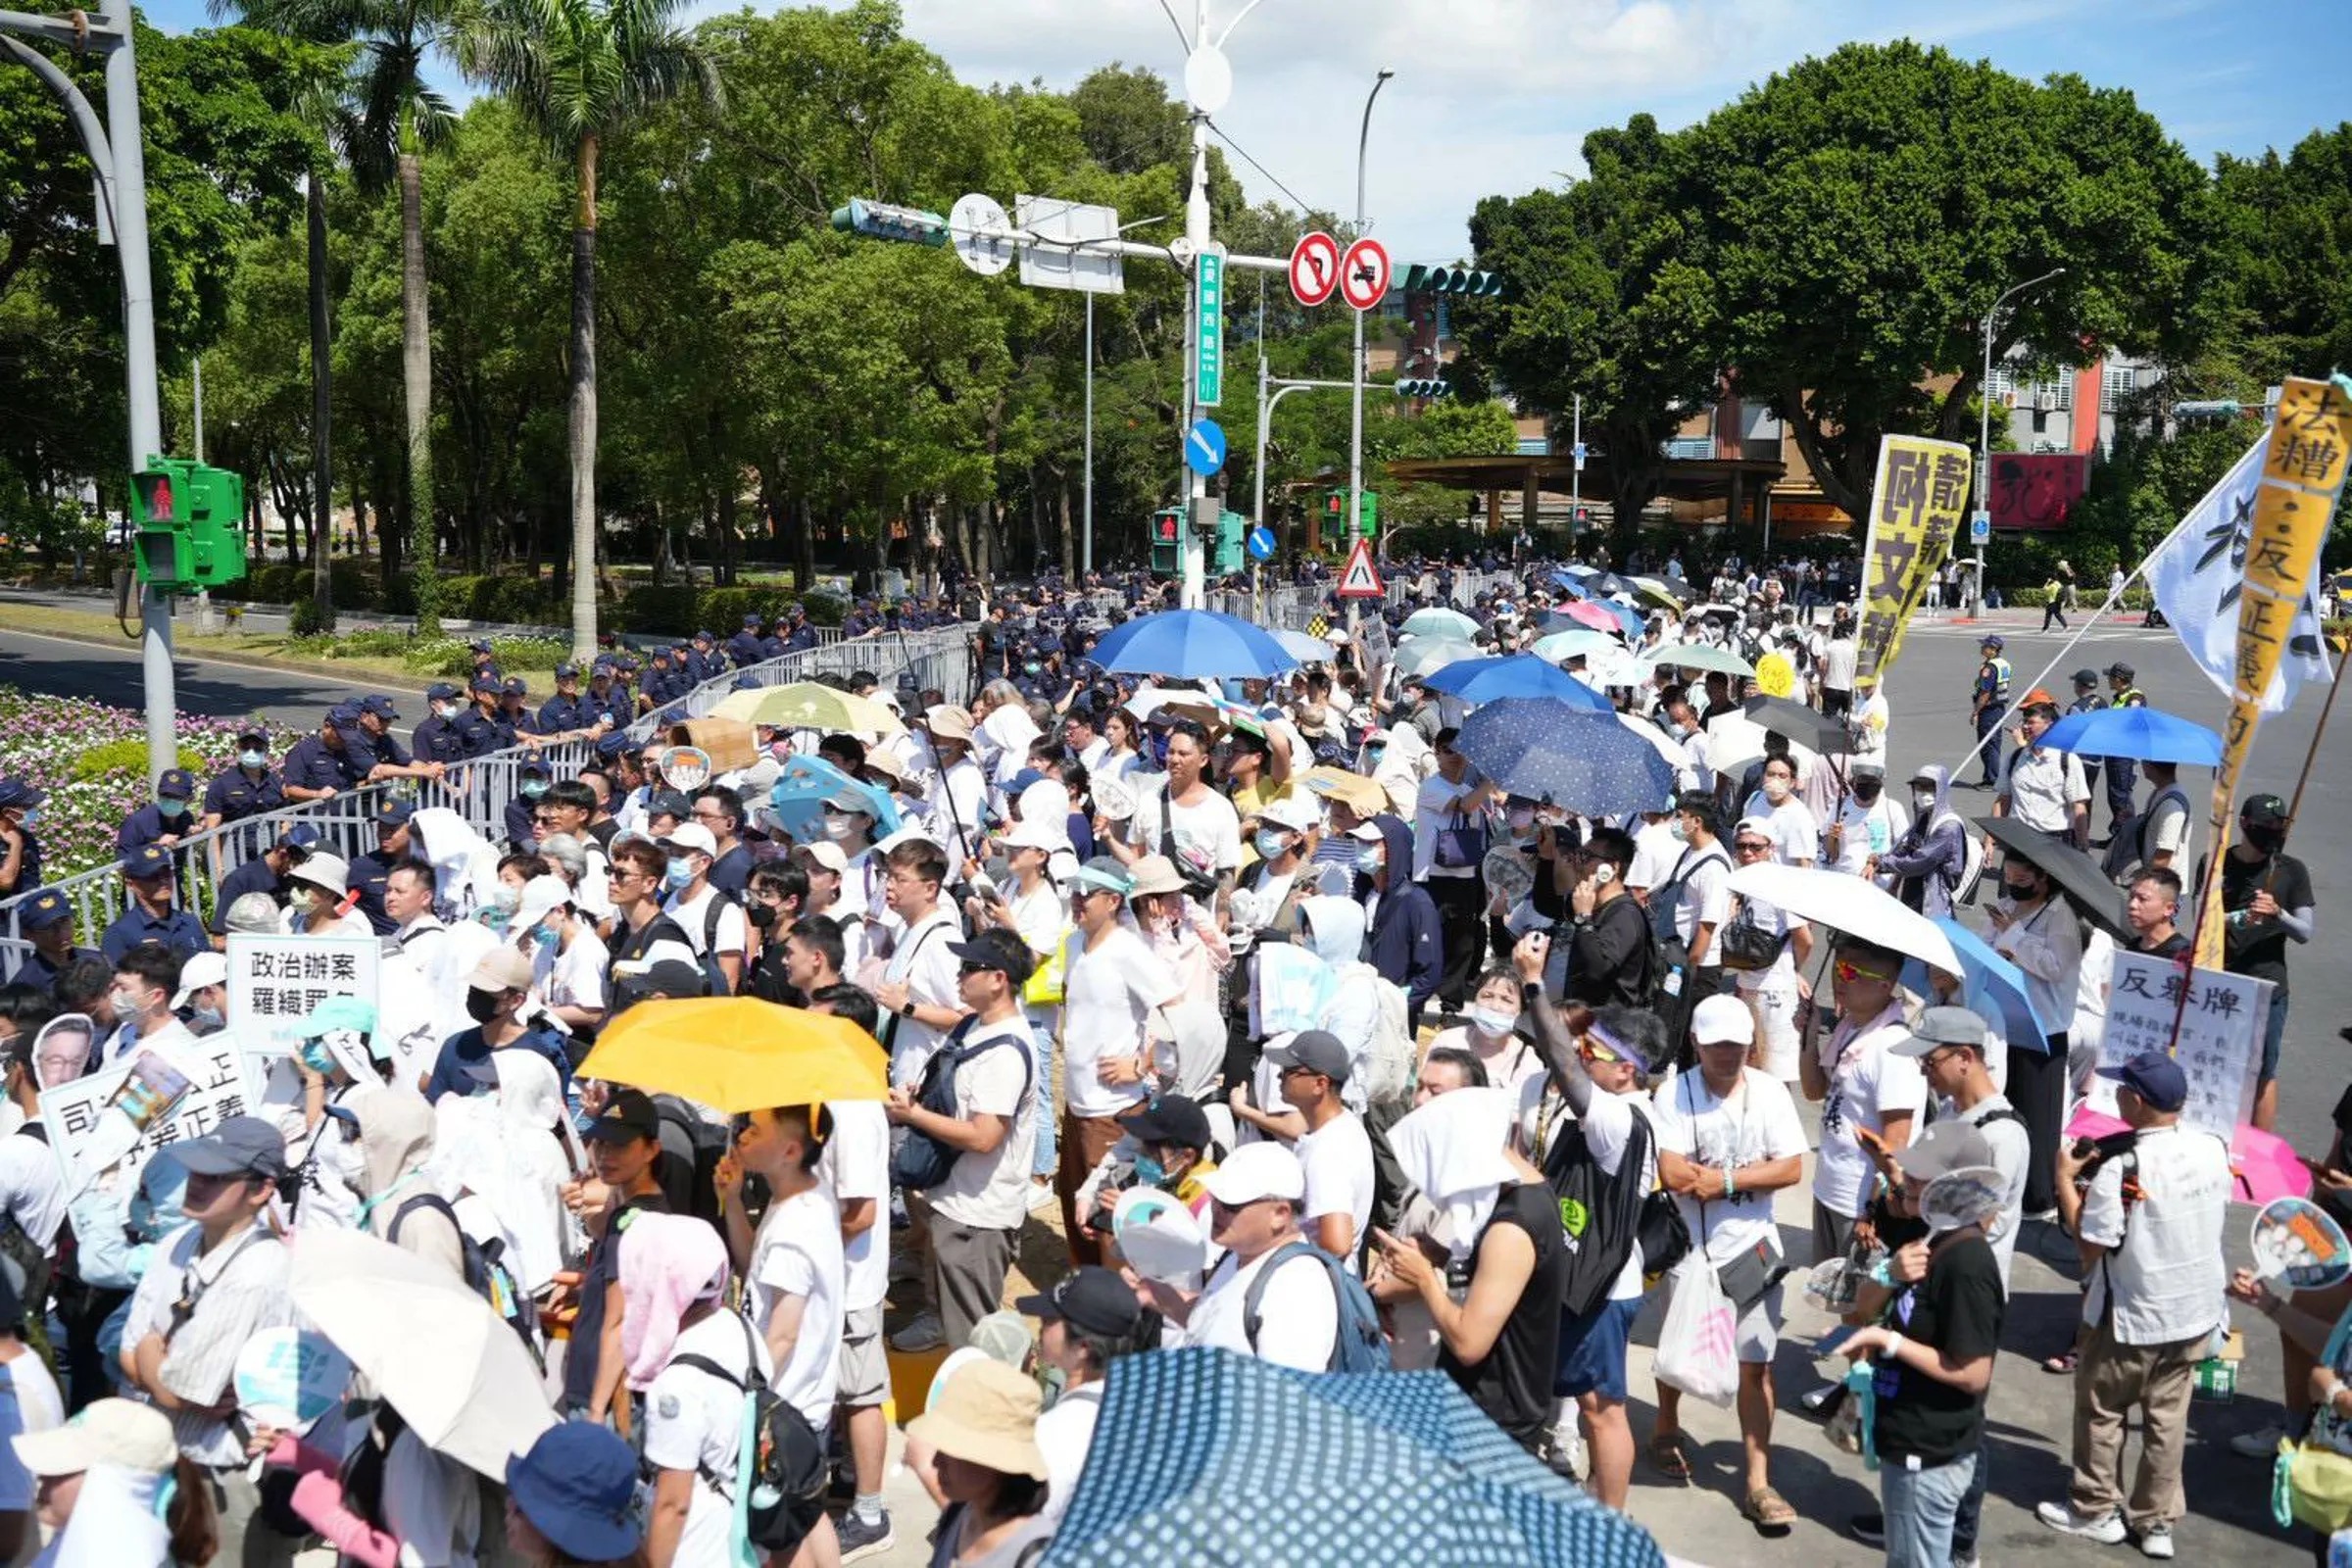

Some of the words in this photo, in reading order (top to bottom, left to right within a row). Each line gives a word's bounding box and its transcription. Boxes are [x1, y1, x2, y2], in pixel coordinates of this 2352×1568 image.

[252, 952, 355, 981] 政治辦案
[253, 987, 355, 1016] 羅織罪
